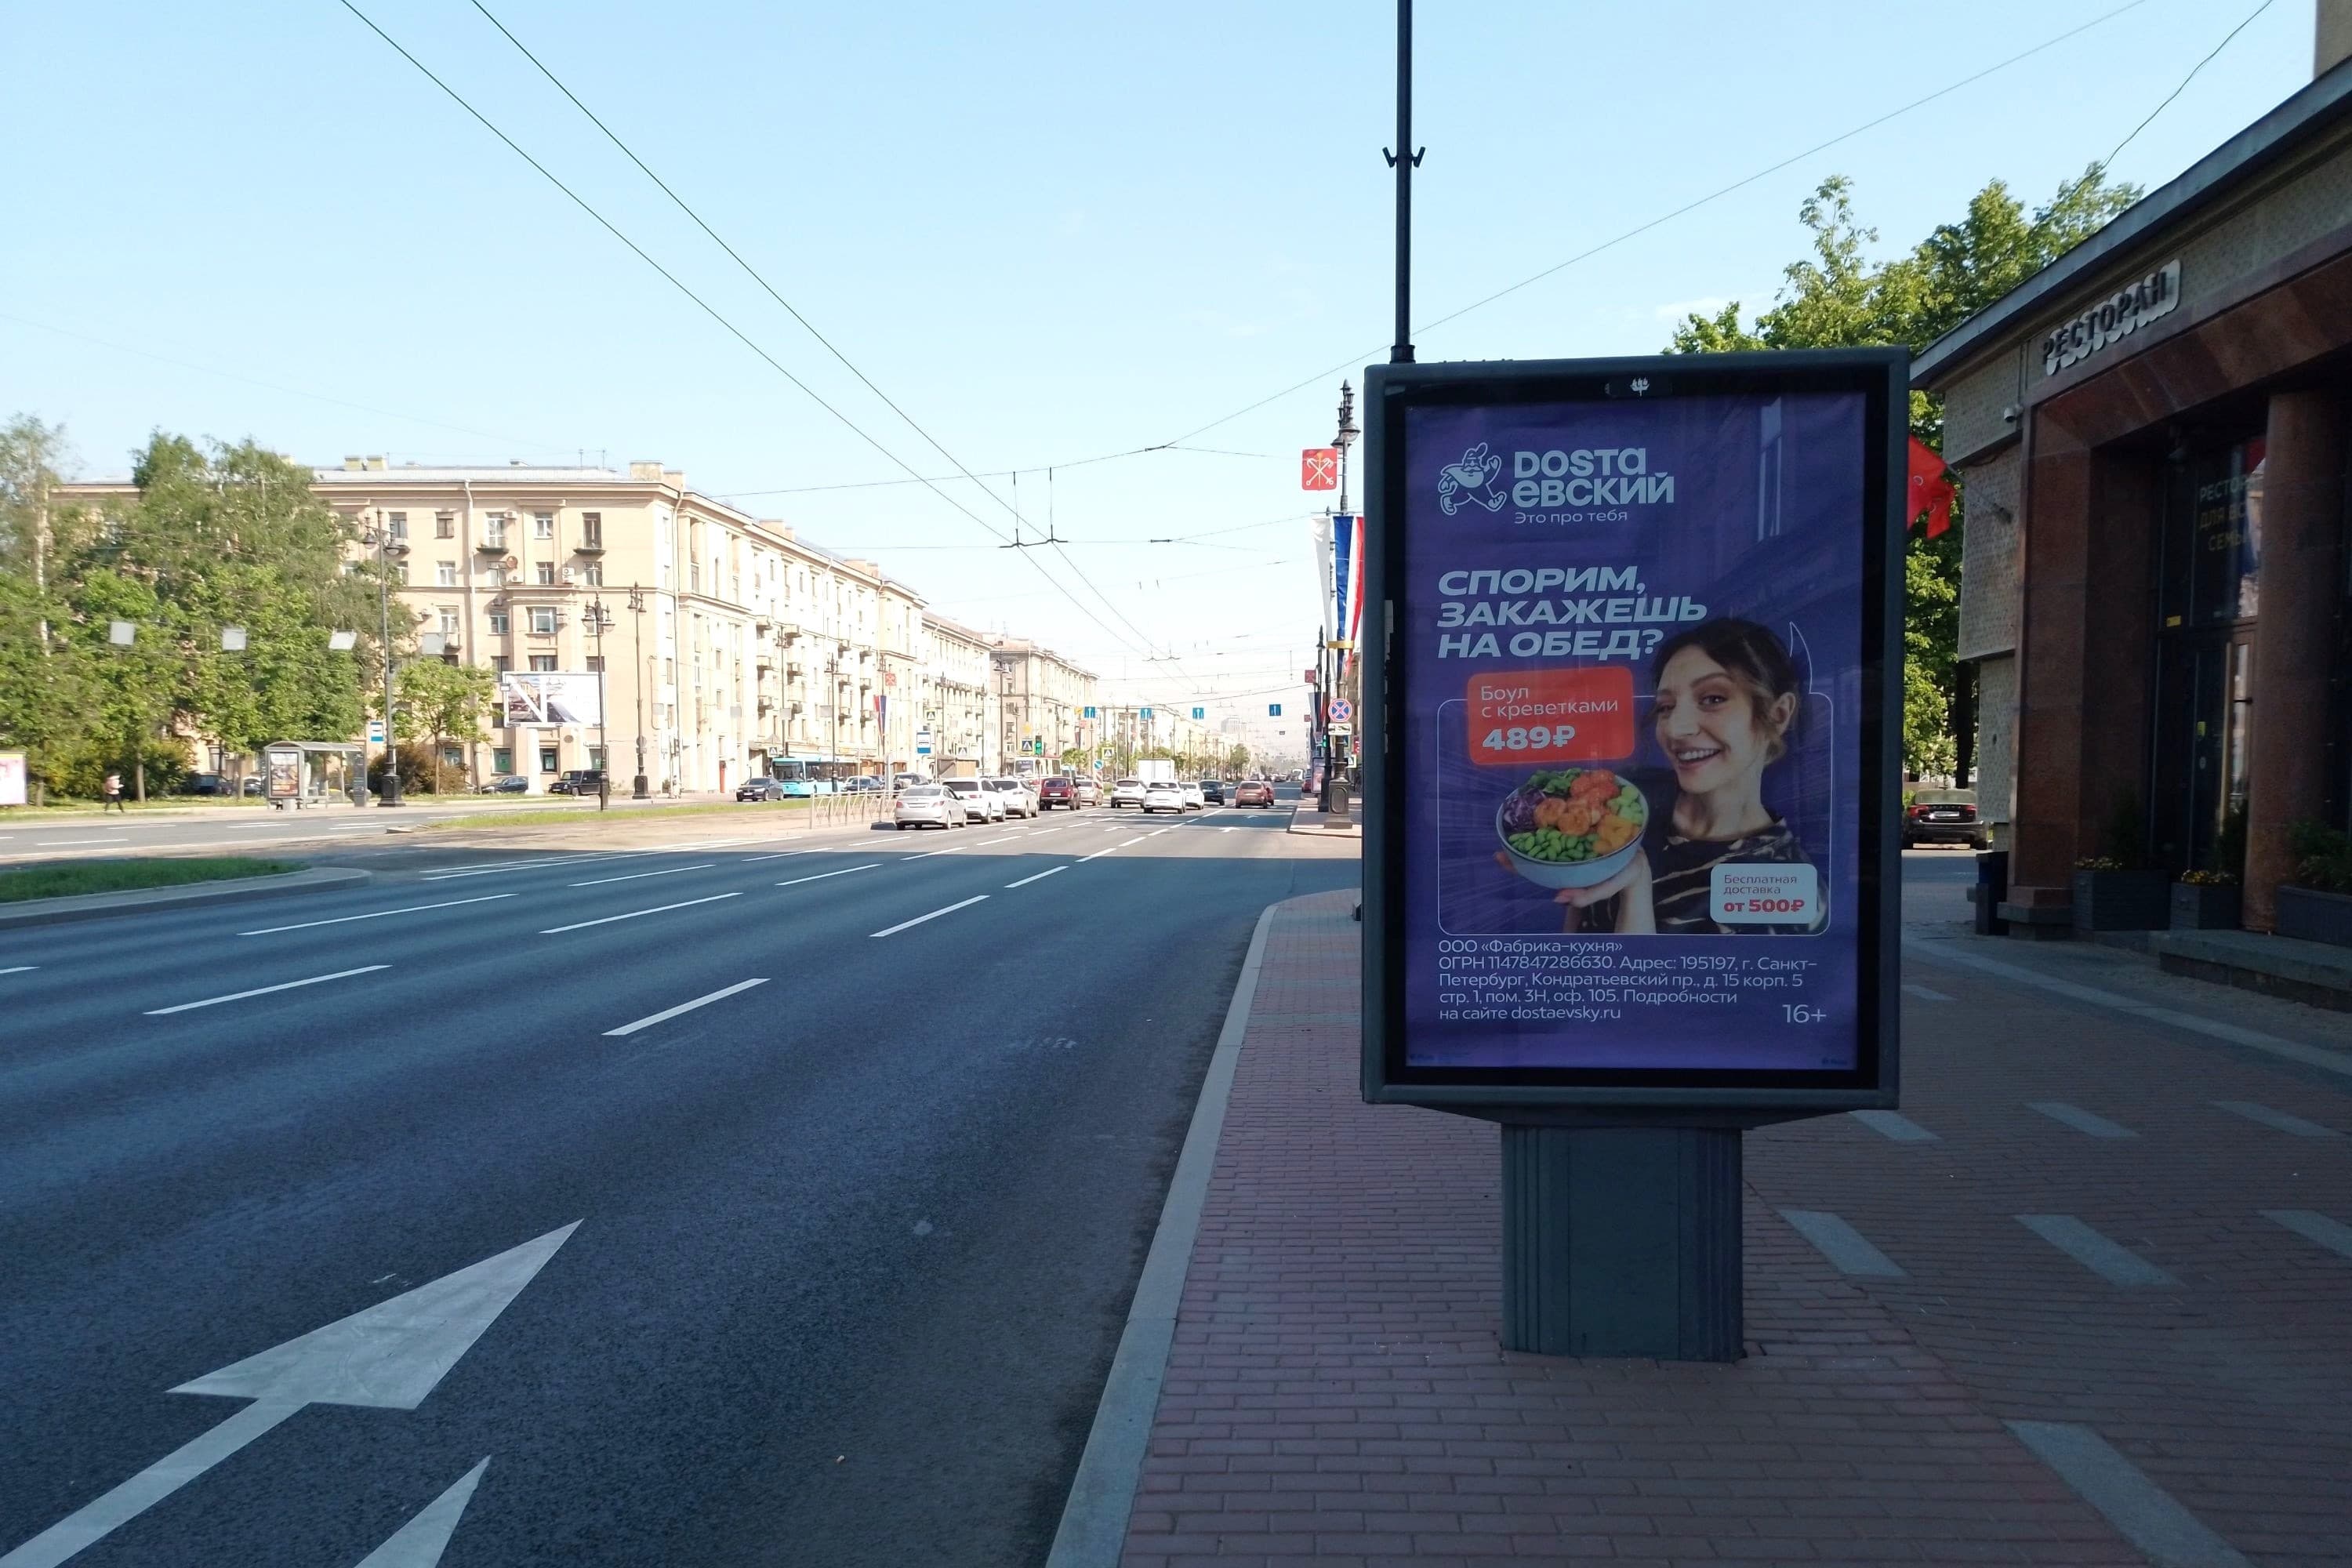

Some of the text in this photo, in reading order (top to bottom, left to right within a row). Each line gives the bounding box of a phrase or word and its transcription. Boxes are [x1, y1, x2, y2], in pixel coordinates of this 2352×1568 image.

[2042, 271, 2167, 365] РЕСТОРАН
[1515, 509, 1628, 525] Это про тебя
[1438, 565, 1646, 598] СПОРИМ,
[1436, 596, 1708, 628] ЗАКАЖЕШЬ
[1437, 629, 1664, 661] НА ОБЕД?
[1481, 685, 1529, 702] Боул
[1482, 699, 1618, 720] с креветками
[1482, 725, 1576, 750] 489₽
[1724, 874, 1797, 884] Бесплатная
[1723, 886, 1781, 895] доставка
[1723, 898, 1805, 913] от 500₽
[1439, 939, 1478, 953] ООО
[1439, 955, 1817, 971] ОГРН 1147847286630. Адрес: 195197, г. Санкт-
[1439, 972, 1803, 989] Петербург, Кондратьевский пр., д. 15 корп. 5
[1439, 989, 1737, 1006] стр. 1, пом. 3Н, оф. 105. Подробности
[1439, 1005, 1621, 1022] на сайте dostaevsky.ru
[1782, 1004, 1828, 1023] 16+
